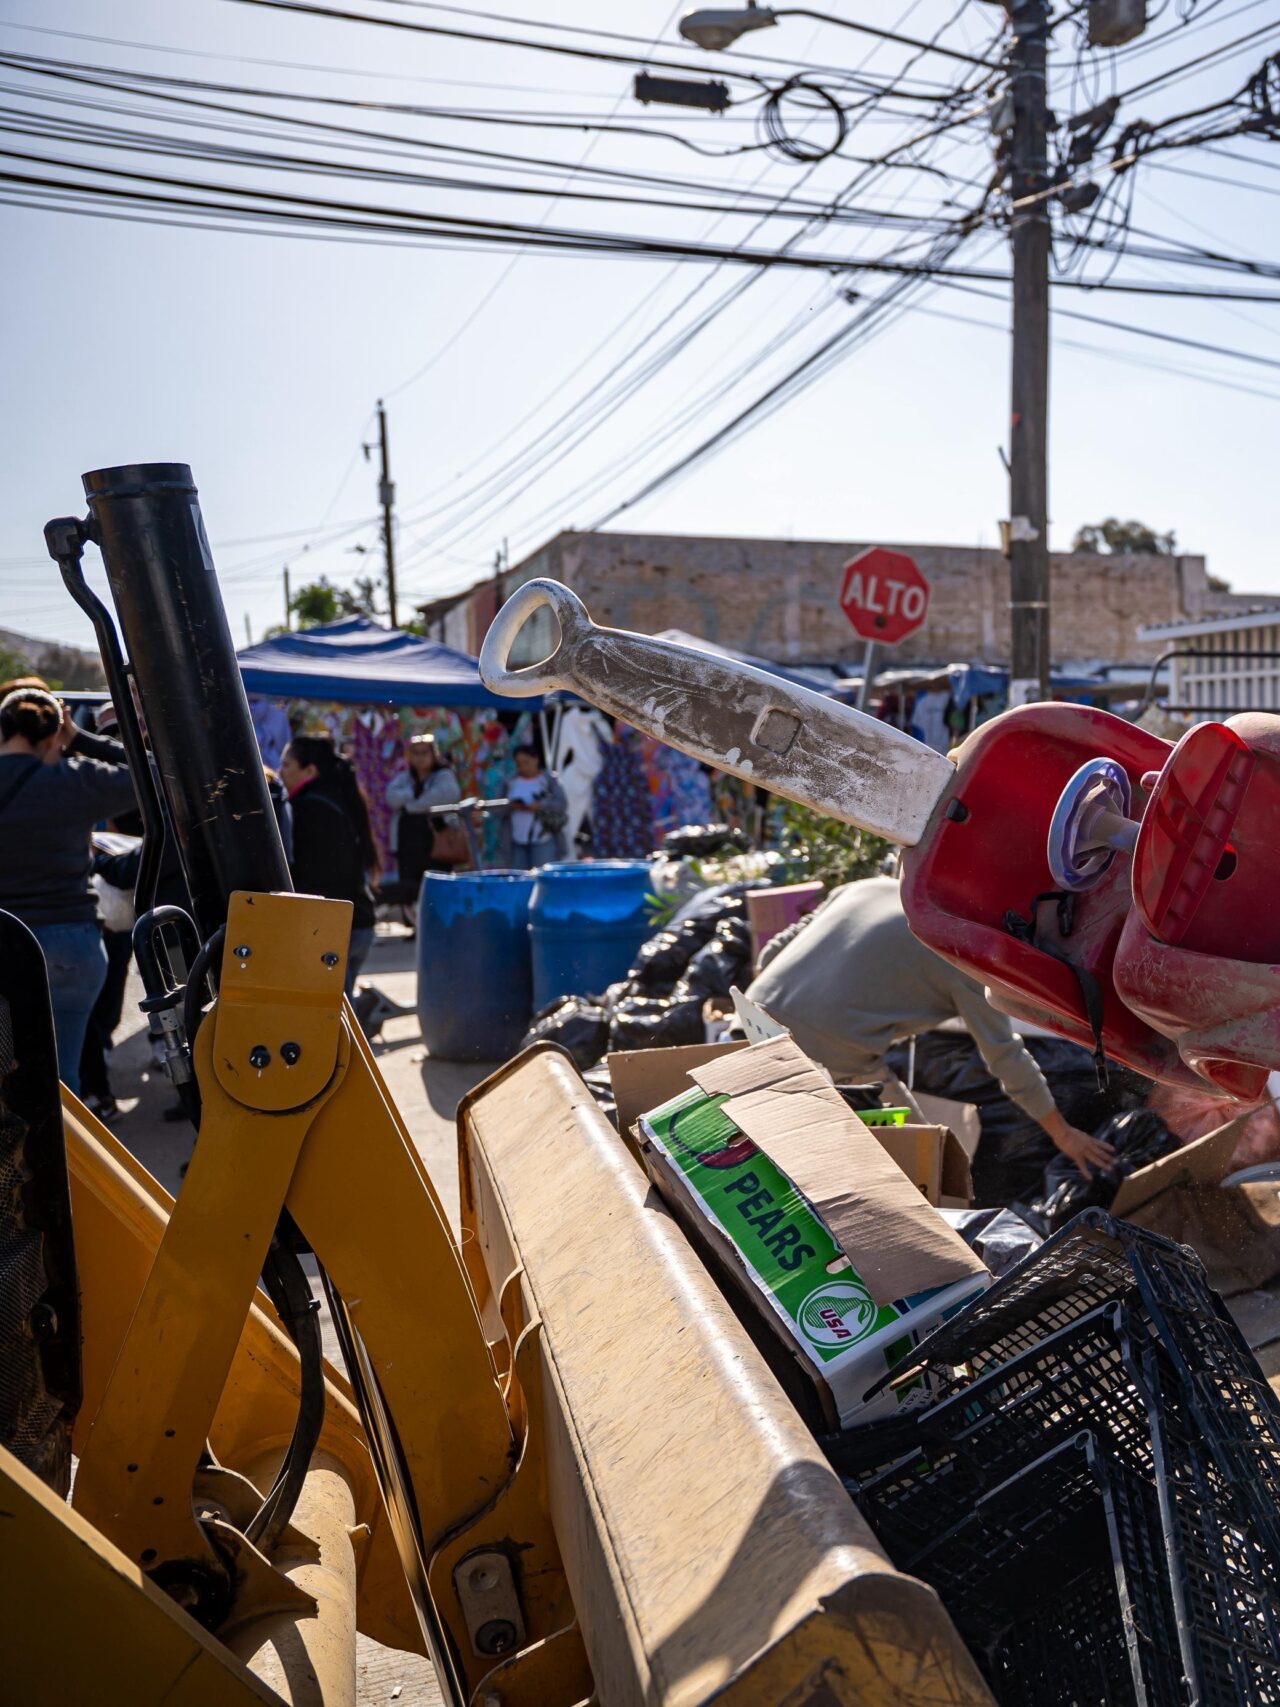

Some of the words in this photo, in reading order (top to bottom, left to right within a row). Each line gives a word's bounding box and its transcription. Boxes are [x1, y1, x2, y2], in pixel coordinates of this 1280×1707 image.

[843, 571, 926, 620] ALTO
[723, 1171, 816, 1271] PEARS
[819, 1308, 852, 1339] USA
